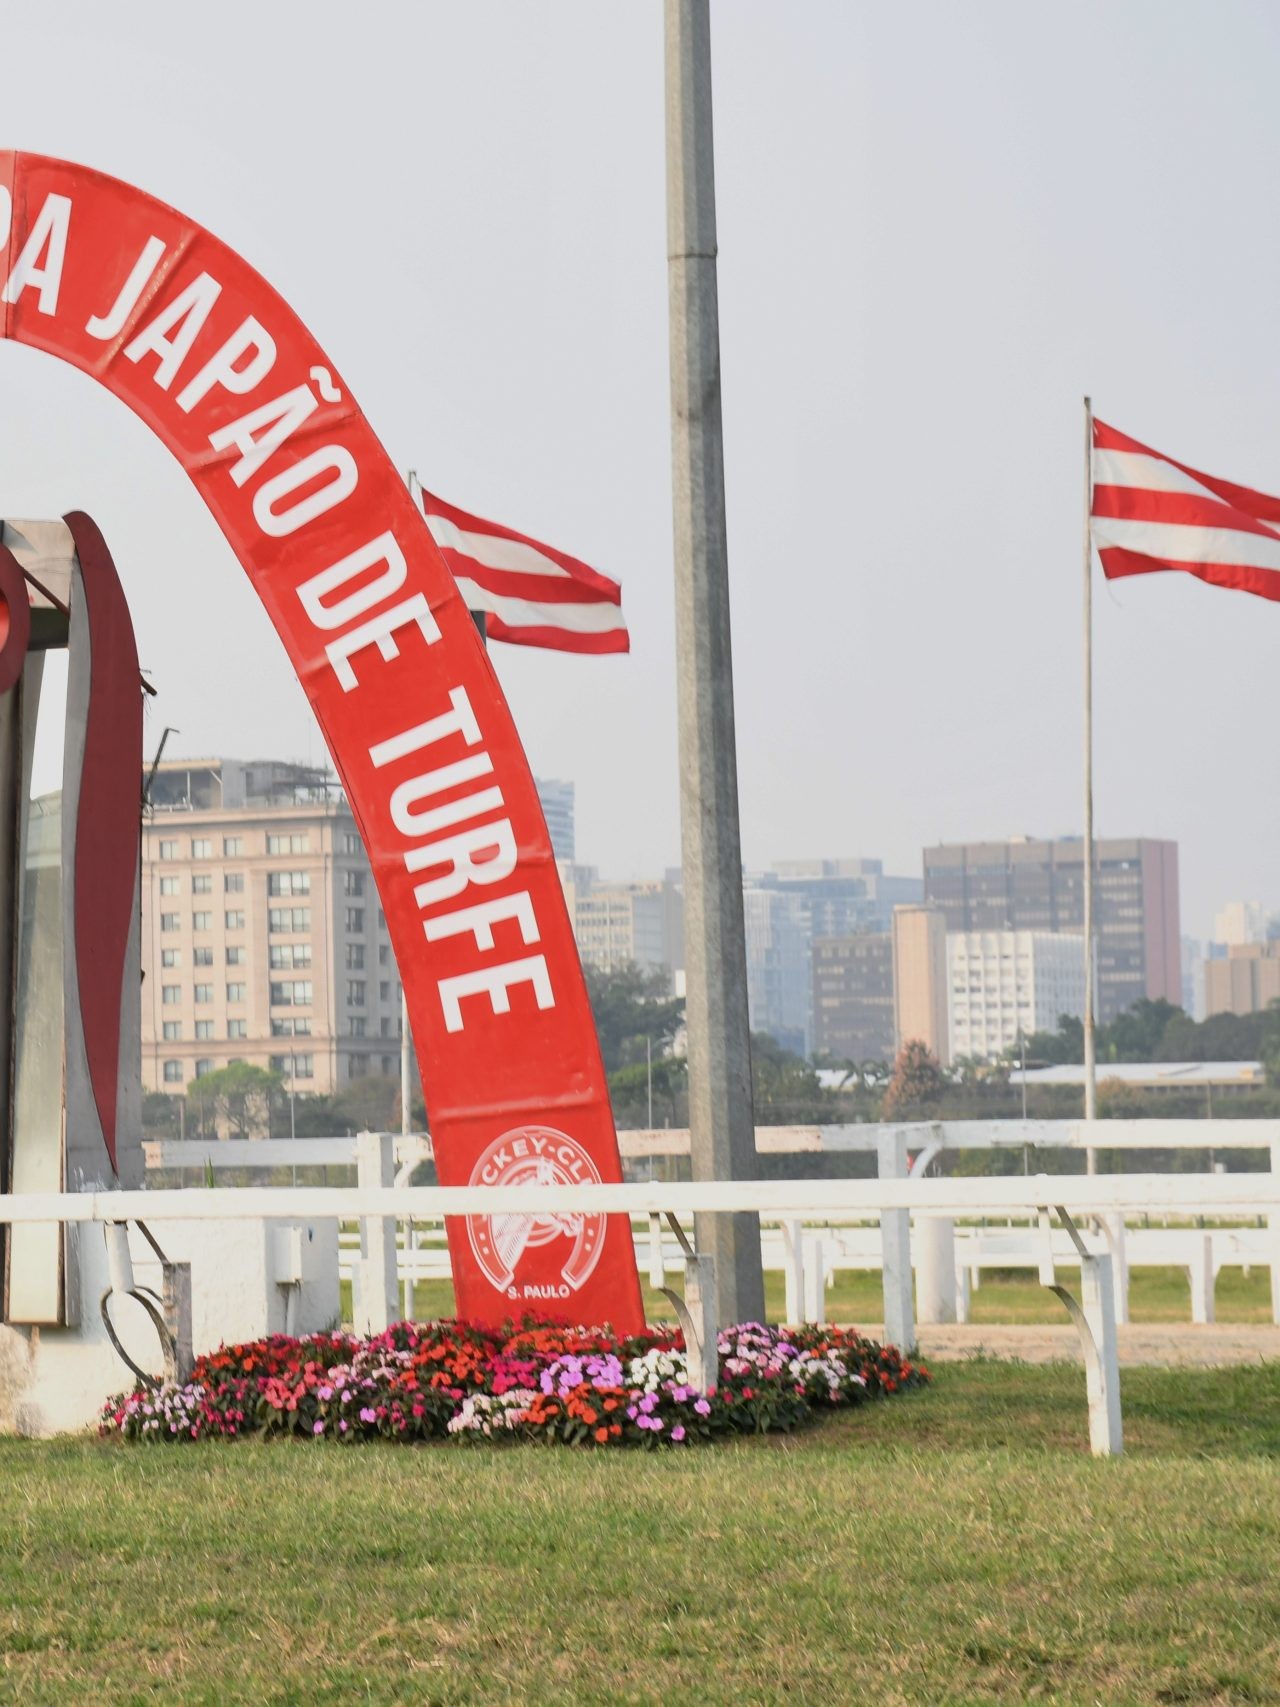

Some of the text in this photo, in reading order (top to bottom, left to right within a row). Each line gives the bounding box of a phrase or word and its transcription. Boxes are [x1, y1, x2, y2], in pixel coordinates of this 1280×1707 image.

[84, 234, 360, 538] JAPÃO
[295, 529, 444, 693] DE
[367, 684, 556, 1034] TURFE
[507, 1283, 571, 1300] S. PAULO
